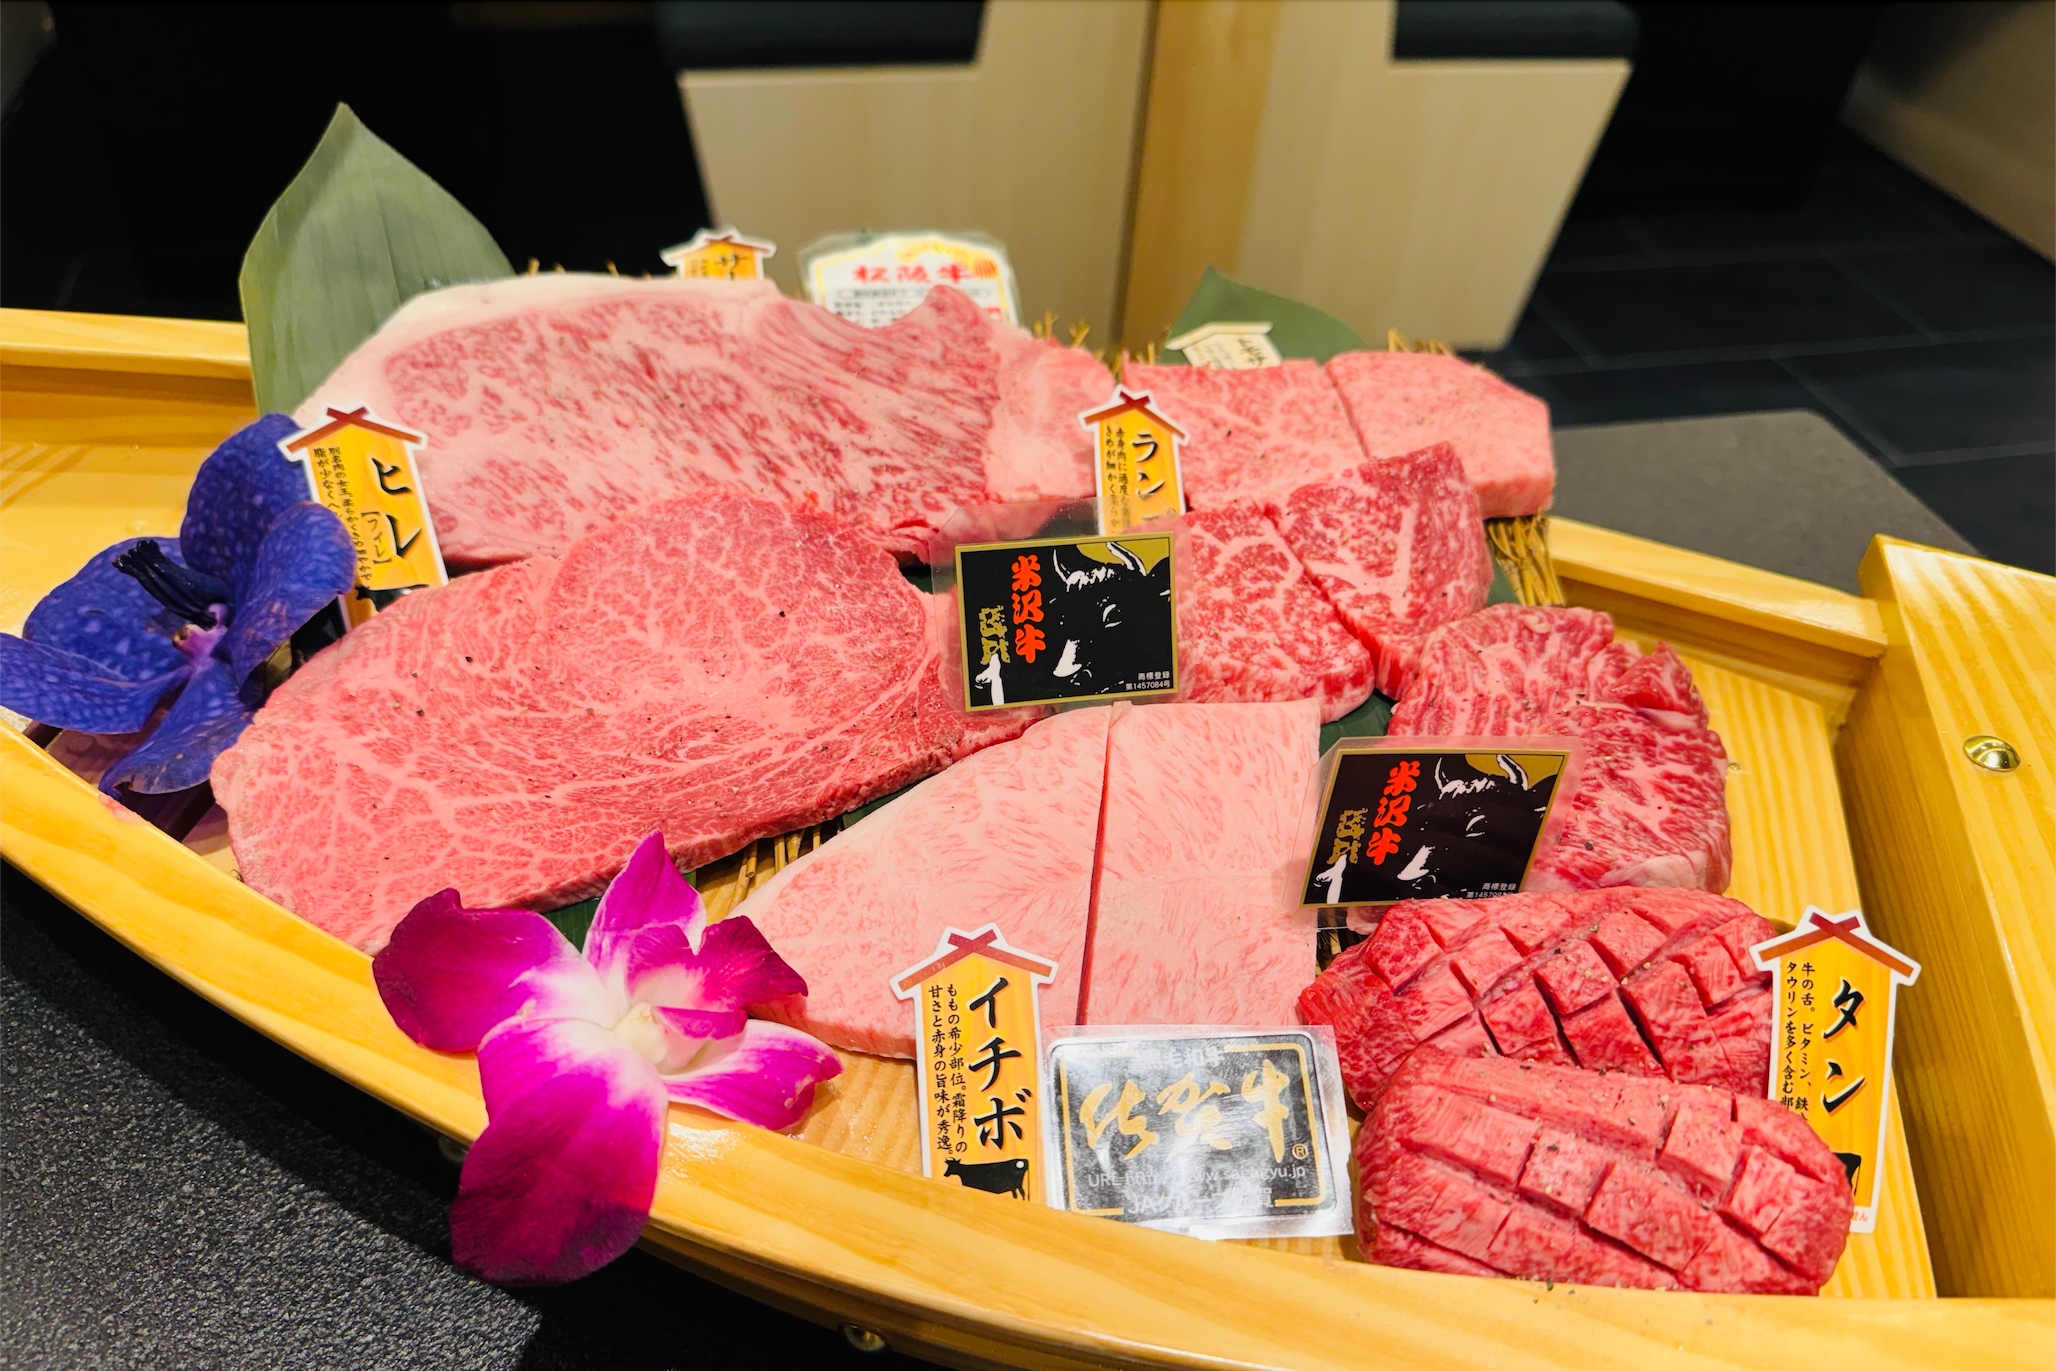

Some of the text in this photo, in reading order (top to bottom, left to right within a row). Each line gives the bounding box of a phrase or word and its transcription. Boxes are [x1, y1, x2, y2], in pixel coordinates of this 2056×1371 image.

[371, 457, 423, 559] ヒレ
[1011, 554, 1047, 664] 米沢牛
[1125, 680, 1170, 691] 第1457084号
[1366, 760, 1421, 866] 米沢牛
[929, 985, 954, 1156] 甘さと赤身の旨味が秀逸。
[947, 984, 968, 1154] ももの希少部位。霜降りの
[968, 977, 1032, 1150] イチボ
[1822, 978, 1866, 1113] タン
